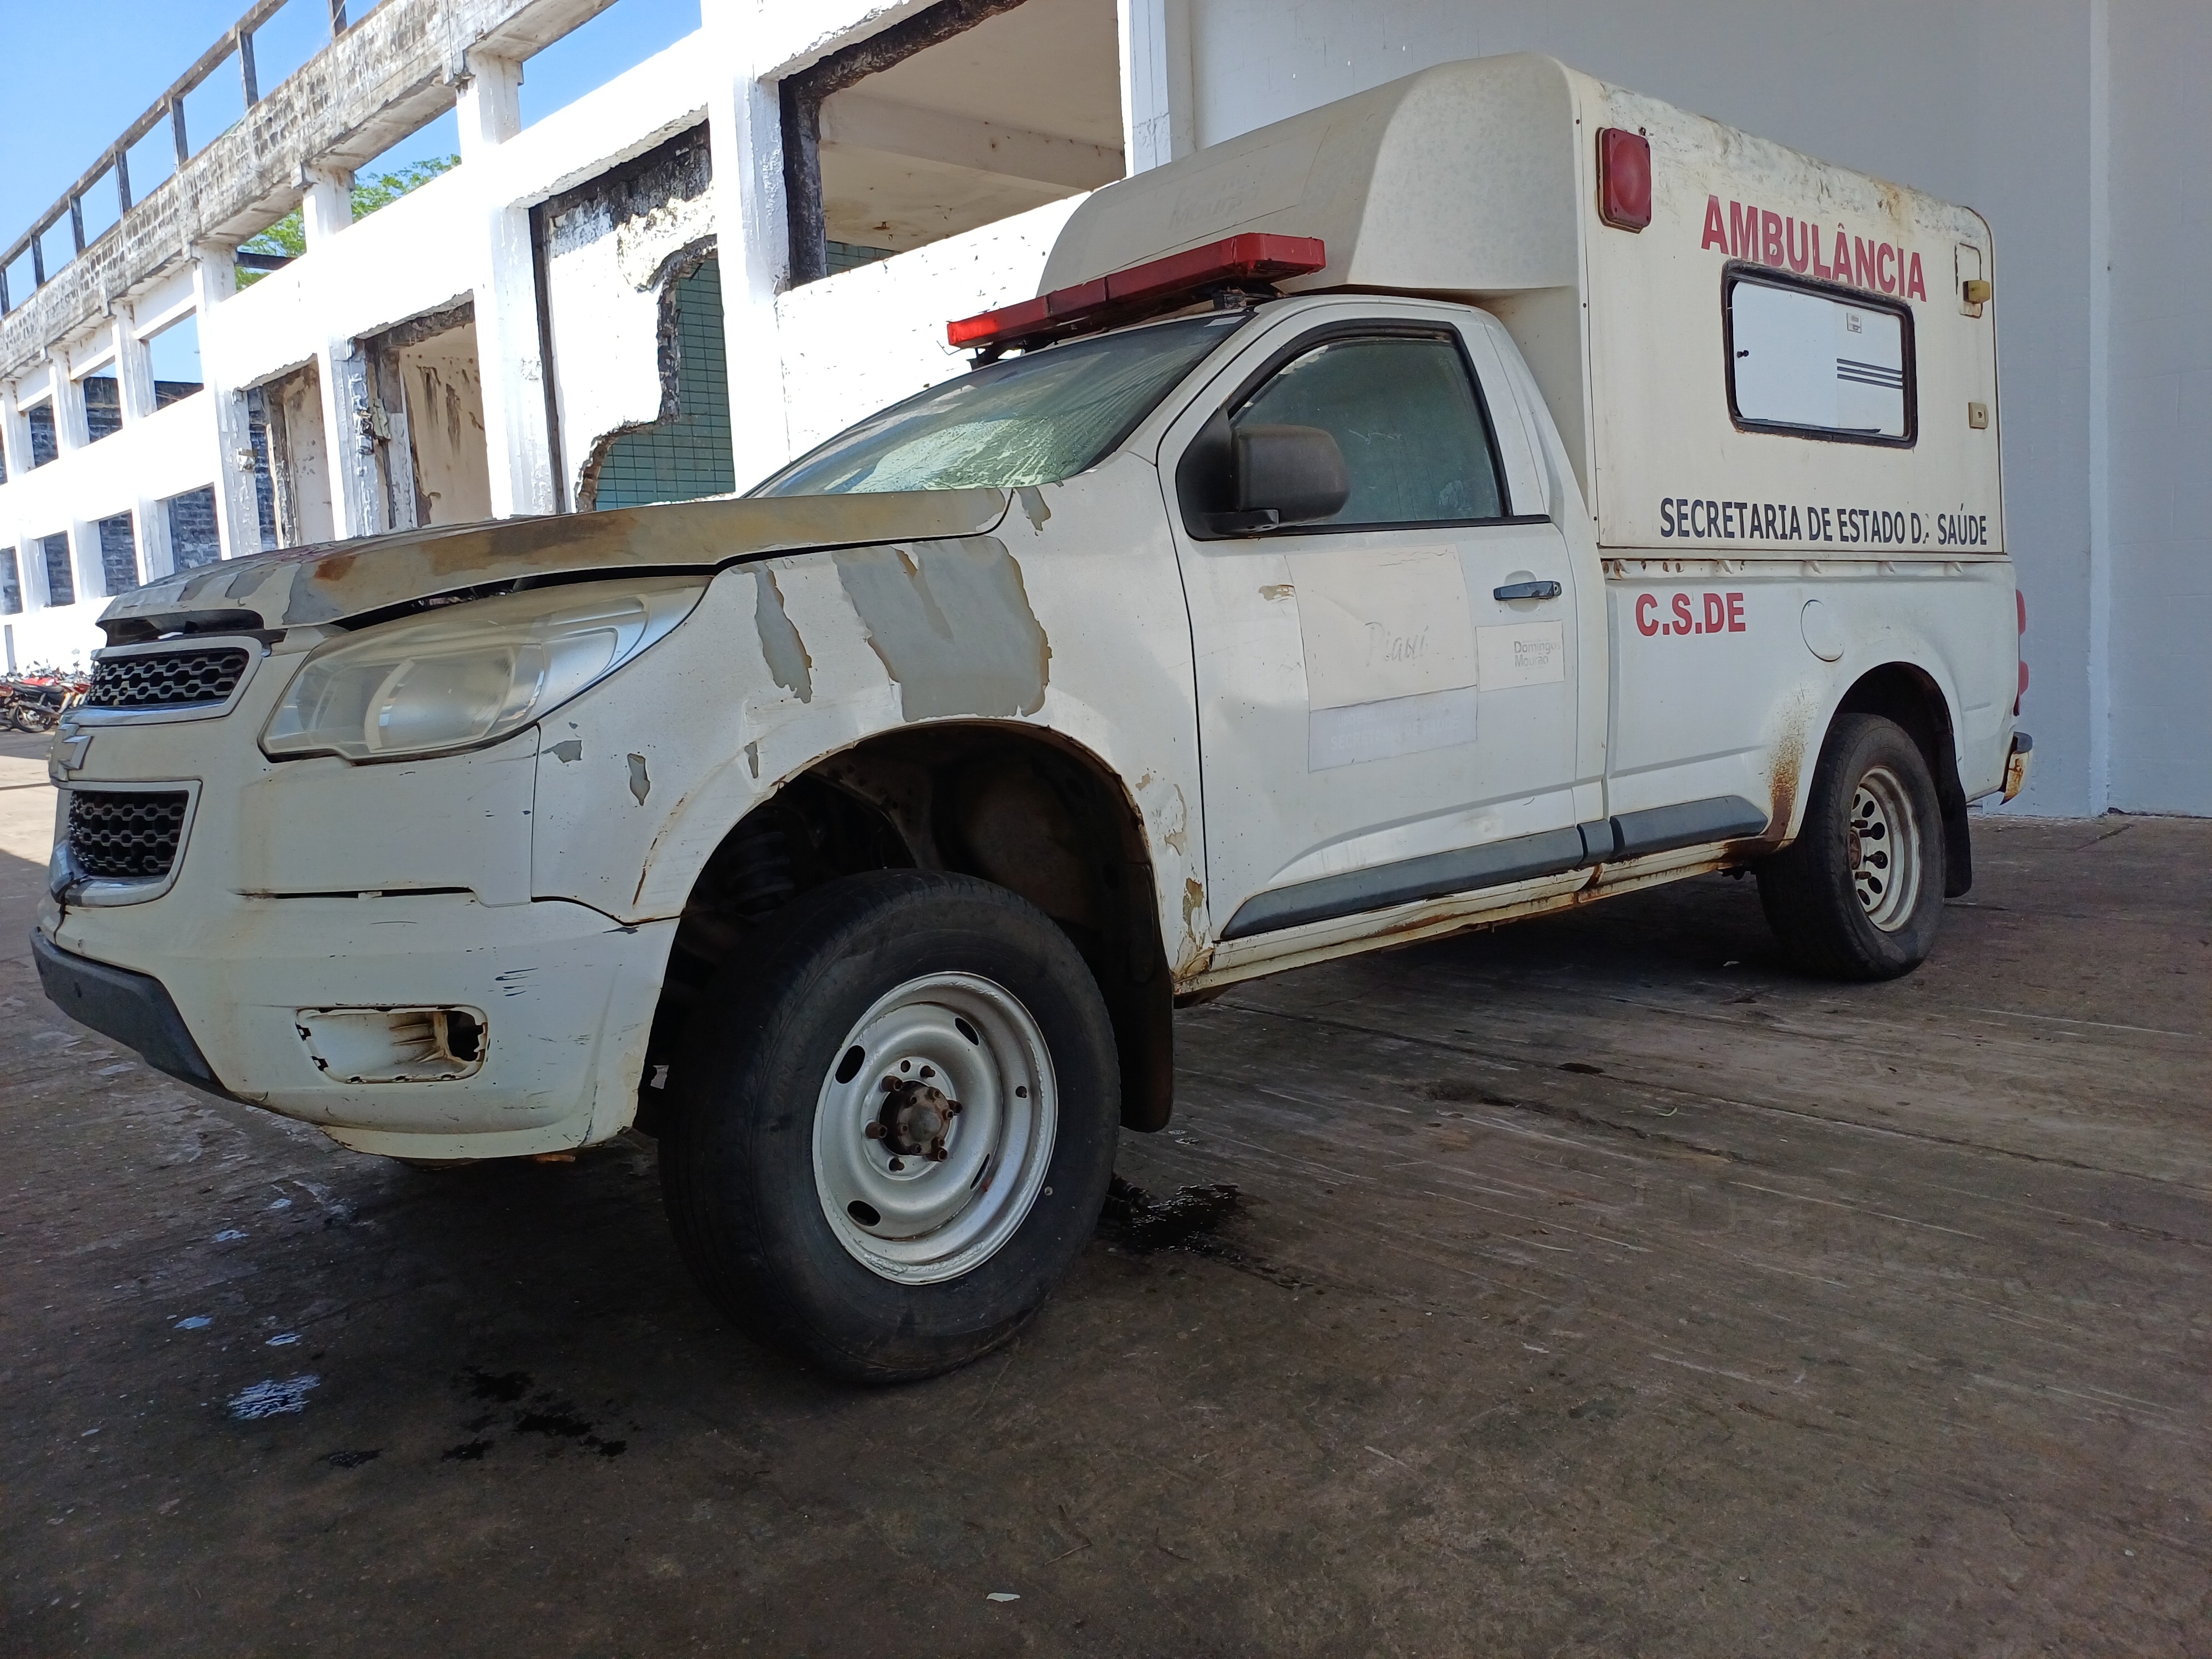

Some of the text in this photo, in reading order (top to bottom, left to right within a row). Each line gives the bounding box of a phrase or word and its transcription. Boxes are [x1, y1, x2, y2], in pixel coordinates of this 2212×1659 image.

[1701, 194, 1927, 302] AMBULÂNCIA
[1660, 497, 1987, 545] SECRETARIA DE ESTADO D SAÚDE
[1635, 593, 1746, 637] C.S.DE
[1514, 640, 1561, 655] Domingos
[1514, 653, 1549, 667] Mourão
